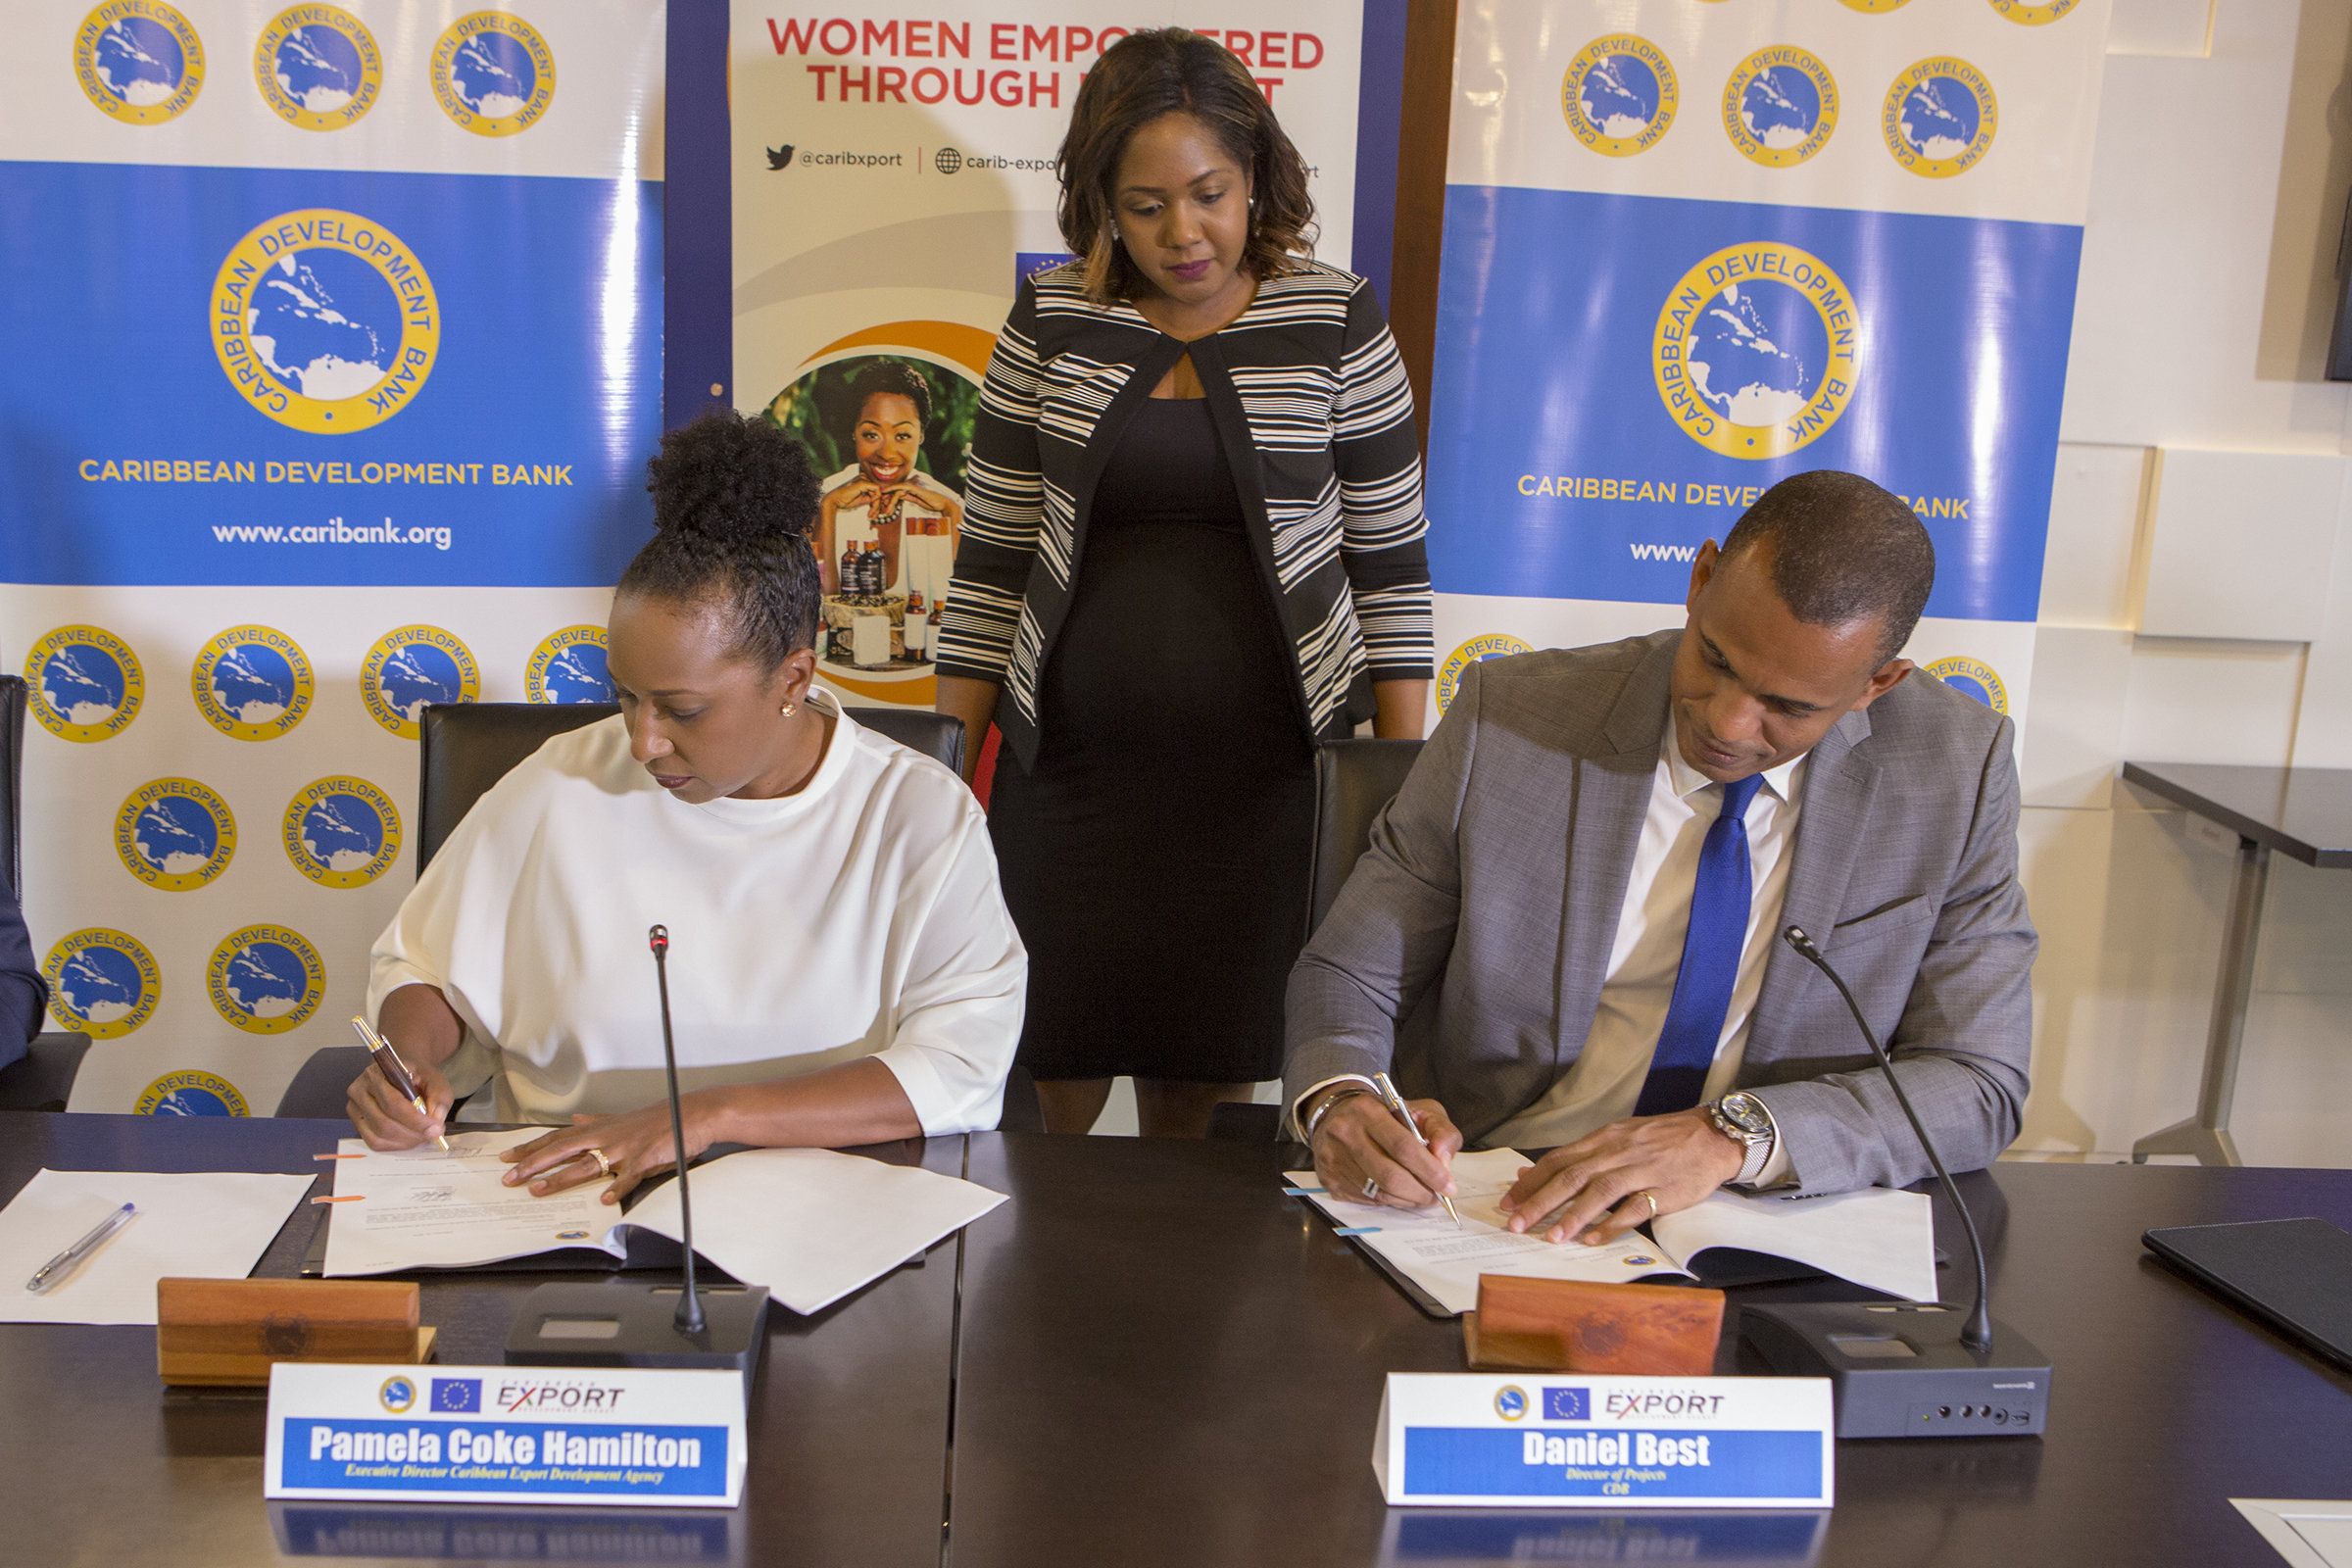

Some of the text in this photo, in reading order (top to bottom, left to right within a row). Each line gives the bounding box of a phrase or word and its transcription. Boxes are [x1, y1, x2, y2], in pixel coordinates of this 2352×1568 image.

[78, 23, 119, 113] CARIBBEAN
[165, 75, 199, 115] BANK
[259, 8, 378, 121] CARIBBEAN DEVELOPMENT BANK
[435, 16, 551, 126] CARIBBEAN DEVELOPMENT BANK
[766, 18, 1324, 70] WOMEN EMPRED
[807, 65, 1060, 109] THROUGH
[1565, 39, 1674, 148] CARIBBEAN DEVELOPMENT BANK
[1726, 50, 1835, 159] CARIBBEAN DEVELOPMENT BANK
[1886, 62, 1994, 169] CARIBBEAN DEVELOPMENT BANK
[799, 150, 903, 169] @caribxport
[966, 155, 1057, 172] carib-expo
[220, 220, 430, 416] CARIBBEAN DEVELOPMENT BANK
[1661, 253, 1855, 443] CARIBBEAN DEVELOPMENT BANK
[79, 460, 573, 486] CARIBBEAN DEVELOPMENT BANK
[1517, 474, 1677, 503] CARIBBEAN
[212, 516, 452, 551] www.caribank.org
[26, 629, 140, 732] CARIBBEAN DEVELOPMENT BANK
[196, 629, 310, 731] CARIBBEAN DEVELOPMENT BANK
[365, 629, 476, 730] CARIBBEAN DEVELOPMENT
[119, 782, 233, 882] CARIBBEAN DEVELOPMENT BANK
[286, 780, 398, 879] CARIBBEAN DEVELOPMENT BANK
[211, 929, 321, 1026] CARIBBEAN DEVELOPMENT BANK
[497, 1387, 625, 1413] EXPORT
[1605, 1395, 1725, 1420] EXPORT
[310, 1426, 701, 1468] Pamela Coke Hamilton
[345, 1463, 664, 1486] Executive Director Caribbean Export Development Agency
[1523, 1431, 1711, 1467] Daniel Best
[1566, 1468, 1610, 1481] Director
